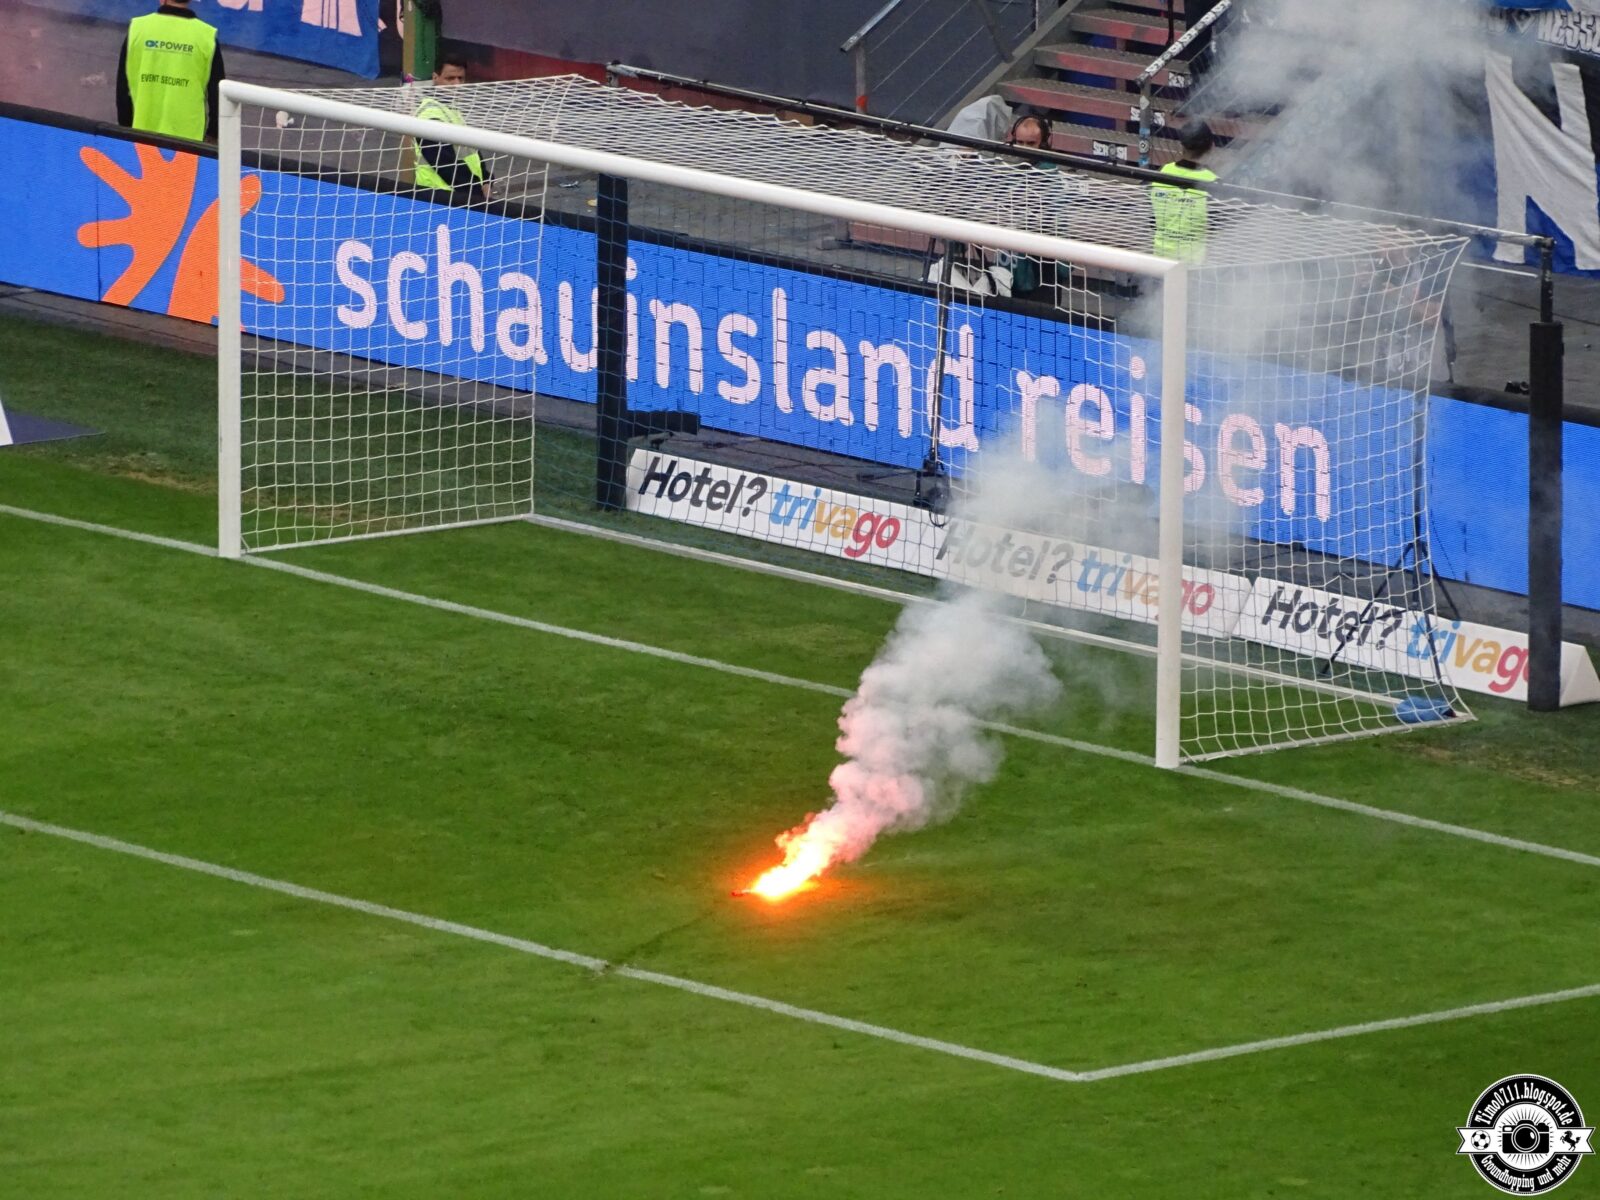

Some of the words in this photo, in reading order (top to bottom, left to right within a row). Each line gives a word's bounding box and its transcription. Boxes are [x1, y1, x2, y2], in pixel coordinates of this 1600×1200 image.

[141, 74, 159, 83] EVENT
[161, 75, 189, 87] SECURITY
[160, 41, 193, 52] POWER
[336, 224, 979, 450] schauinsland
[638, 456, 768, 518] Hotel?
[769, 483, 901, 559] trivago
[936, 519, 1074, 584] Hotel?
[1261, 585, 1403, 650] Hotel?
[1406, 615, 1529, 693] trivag
